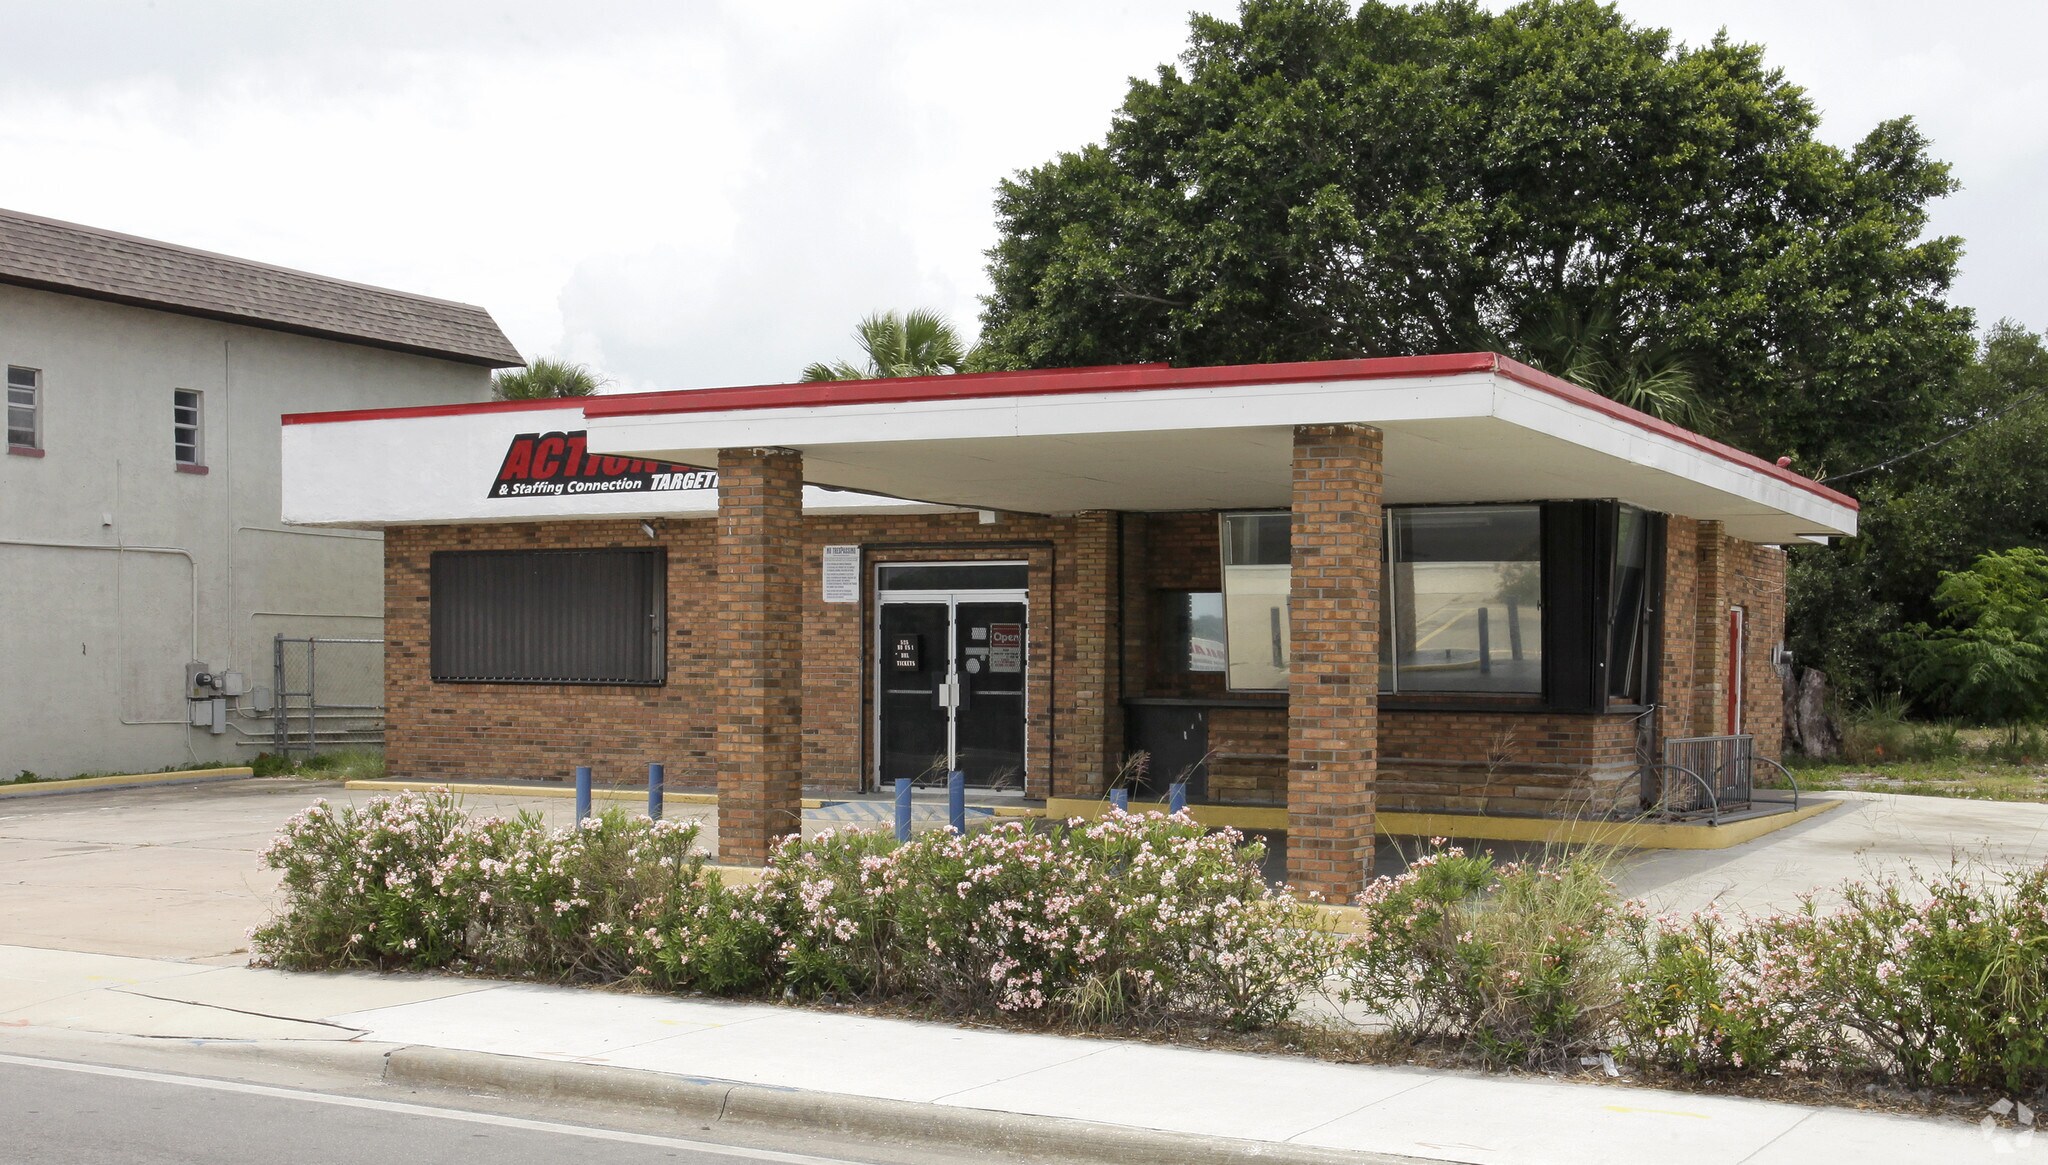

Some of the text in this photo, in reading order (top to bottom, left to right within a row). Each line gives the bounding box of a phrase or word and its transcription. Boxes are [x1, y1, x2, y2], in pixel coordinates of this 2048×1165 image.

[498, 477, 643, 496] & Staffing Connection
[993, 632, 1019, 644] Open
